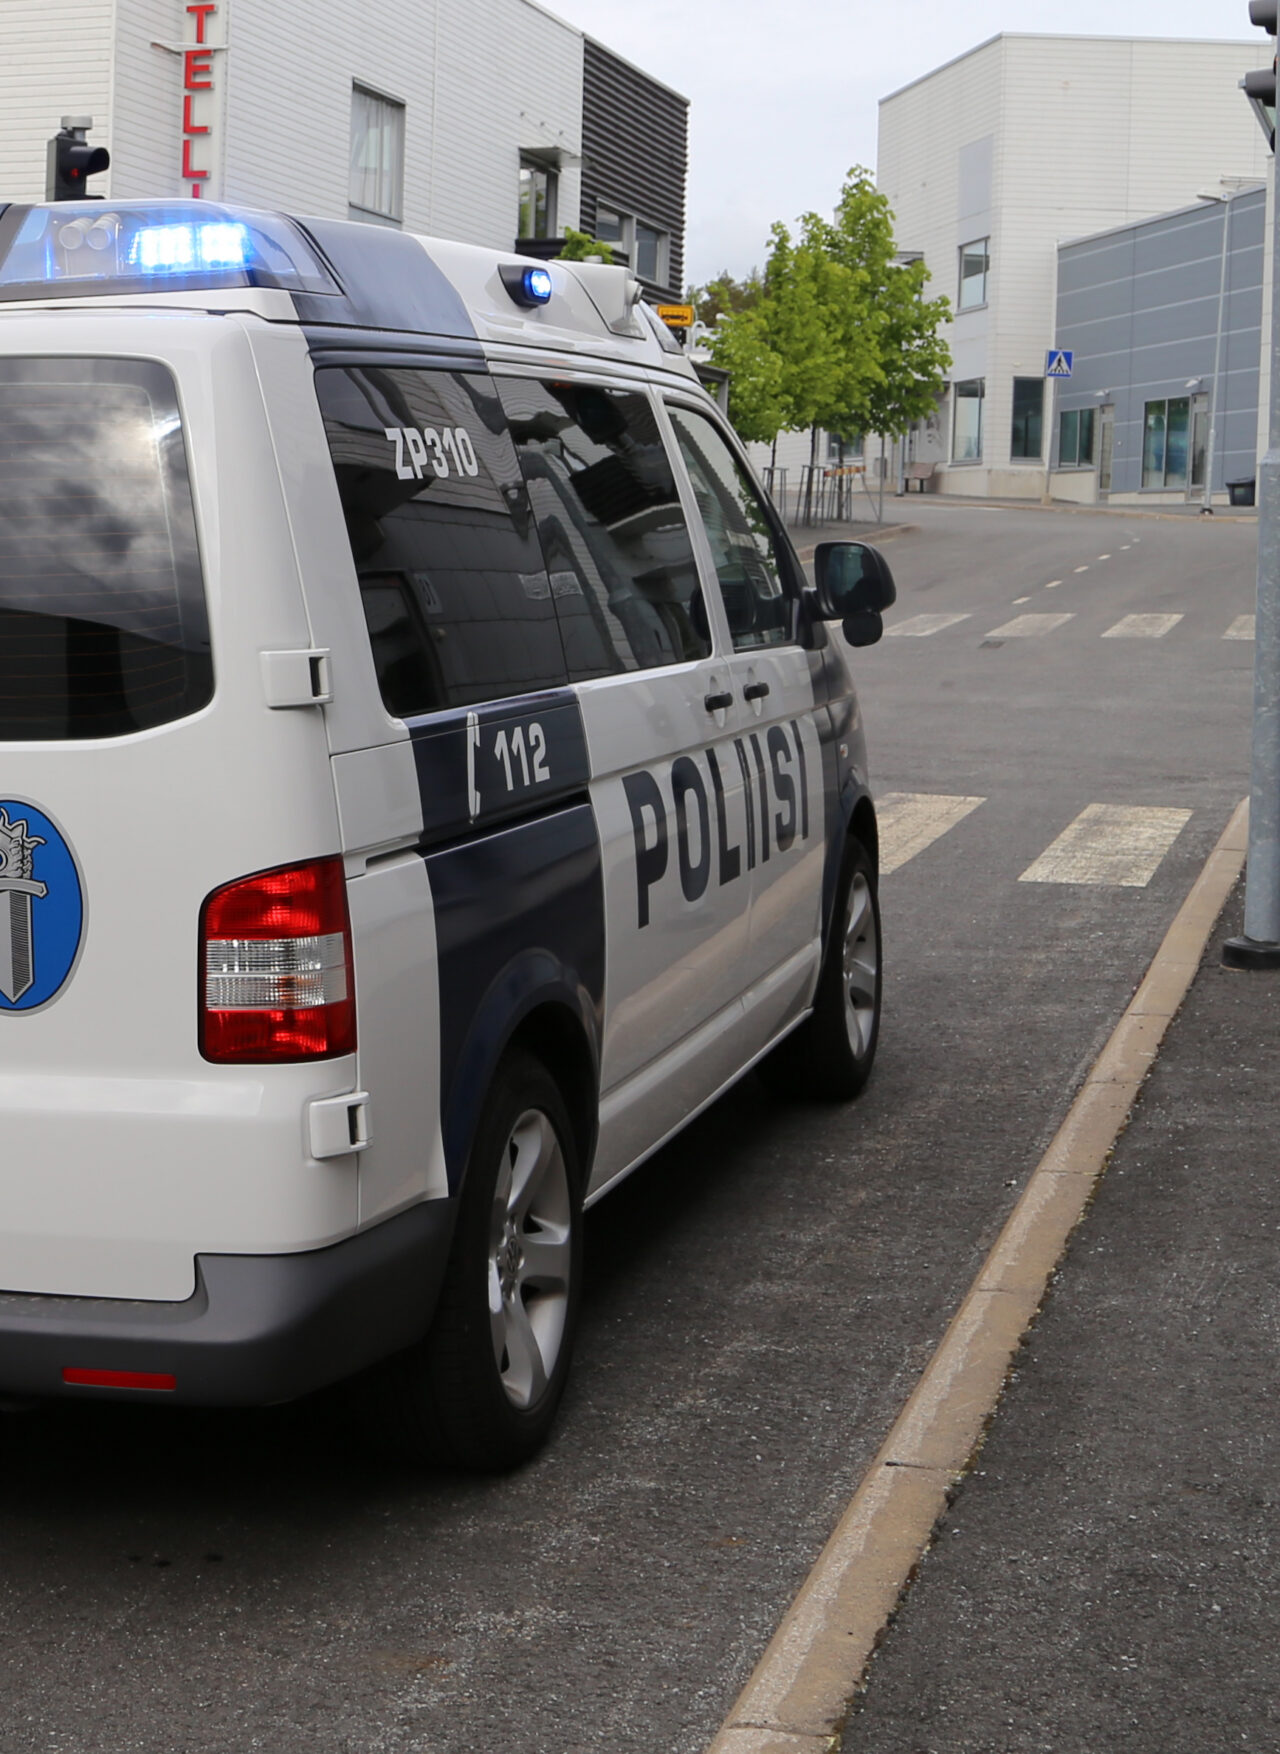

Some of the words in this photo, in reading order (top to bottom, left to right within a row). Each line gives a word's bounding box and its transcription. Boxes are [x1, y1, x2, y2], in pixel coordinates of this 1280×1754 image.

[385, 427, 480, 480] ZP310
[494, 722, 551, 791] 112
[622, 720, 809, 929] POLIISI
